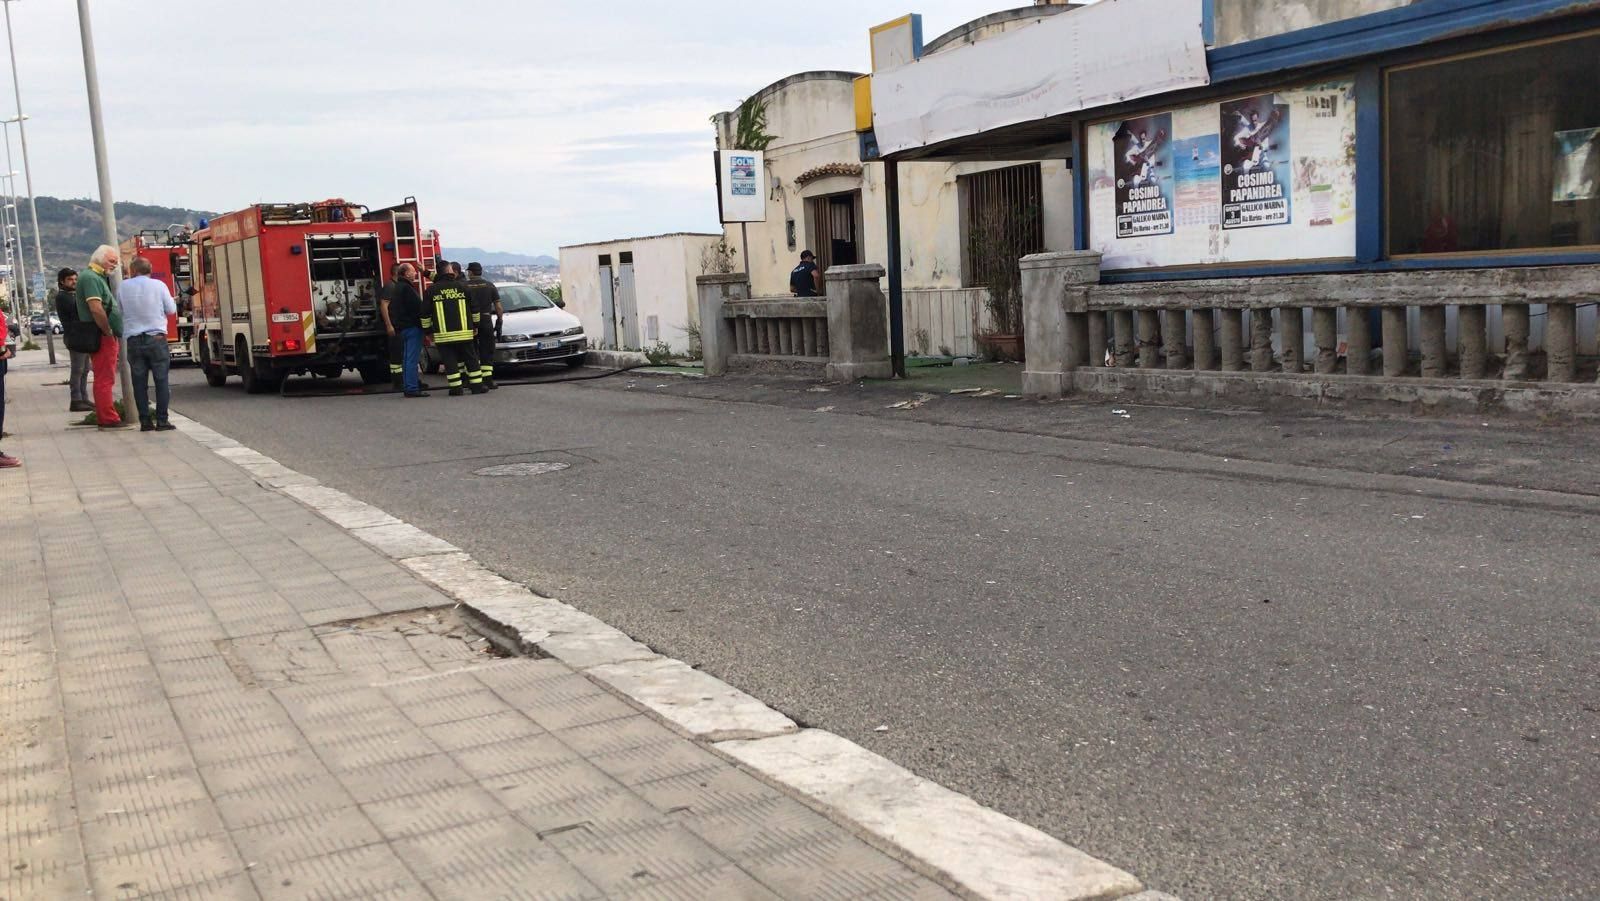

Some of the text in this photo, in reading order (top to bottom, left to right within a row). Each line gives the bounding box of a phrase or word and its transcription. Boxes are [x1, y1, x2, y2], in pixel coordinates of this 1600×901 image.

[1237, 171, 1274, 188] COSIMO
[1128, 185, 1160, 201] COSIMO
[1230, 184, 1283, 202] PAPANDREA
[1122, 197, 1167, 214] PAPANDREA
[1241, 201, 1285, 212] GALLICO MARINA
[1132, 214, 1152, 223] GALLICO
[1151, 212, 1169, 221] MARINA
[1231, 211, 1236, 219] 3
